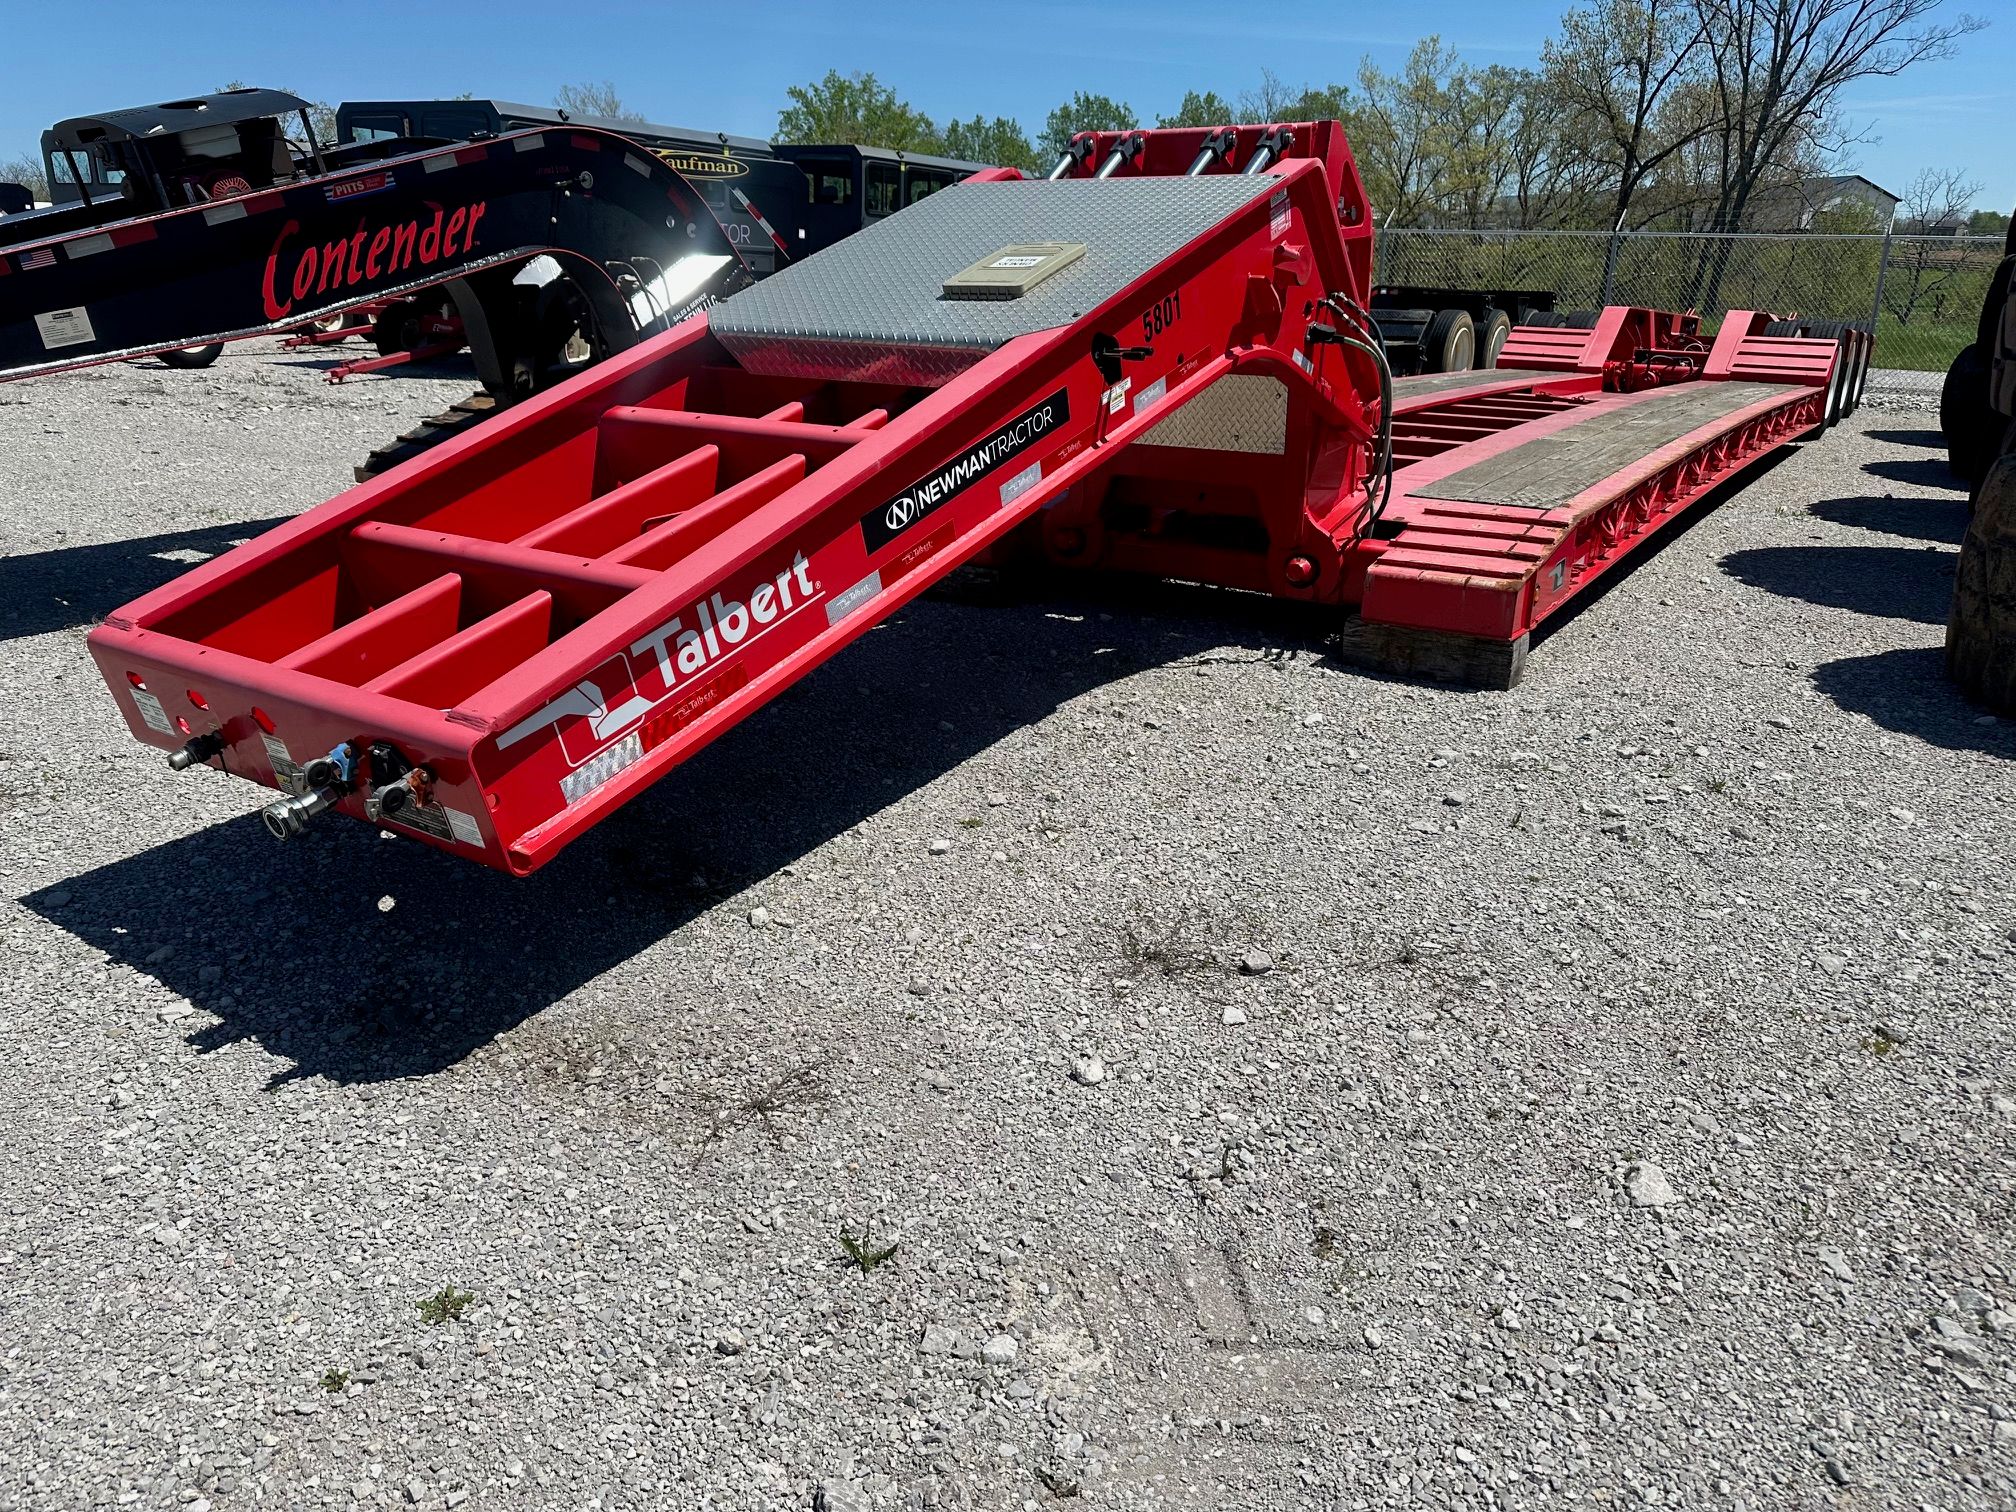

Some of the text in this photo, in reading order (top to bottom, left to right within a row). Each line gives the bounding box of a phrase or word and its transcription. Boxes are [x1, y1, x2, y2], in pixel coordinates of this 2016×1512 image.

[661, 153, 739, 174] aufman
[335, 181, 365, 196] PITTS
[262, 199, 485, 320] Contender
[1142, 288, 1181, 343] 5801
[630, 550, 814, 688] Talbert
[688, 689, 715, 710] Talbert
